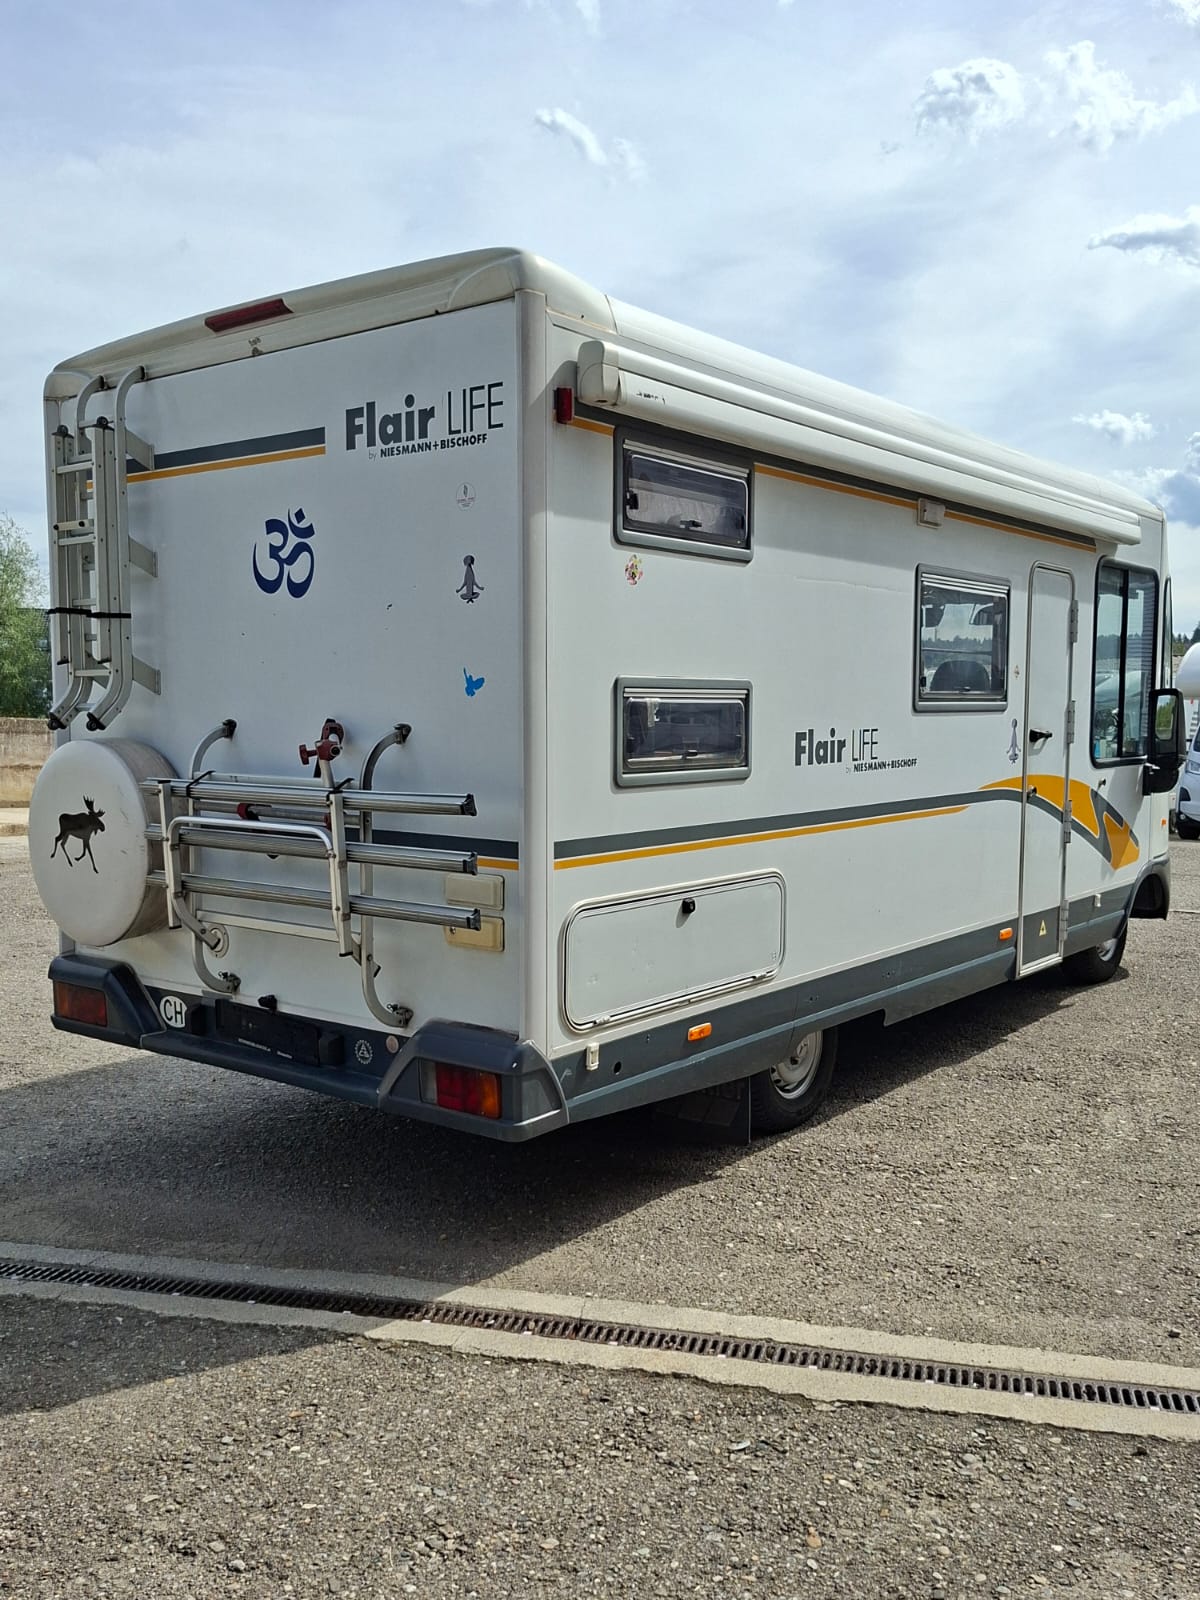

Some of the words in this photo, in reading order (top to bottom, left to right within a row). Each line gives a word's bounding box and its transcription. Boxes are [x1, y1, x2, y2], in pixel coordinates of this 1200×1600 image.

[346, 394, 435, 451] Flair
[448, 381, 504, 435] LIFE
[369, 450, 377, 460] by
[380, 433, 488, 458] NIESMANN+BISCHOFF
[795, 727, 846, 766] Flair
[852, 728, 879, 762] LIFE
[853, 758, 918, 773] NIESMANN+BISCHOFF
[163, 998, 184, 1025] CH
